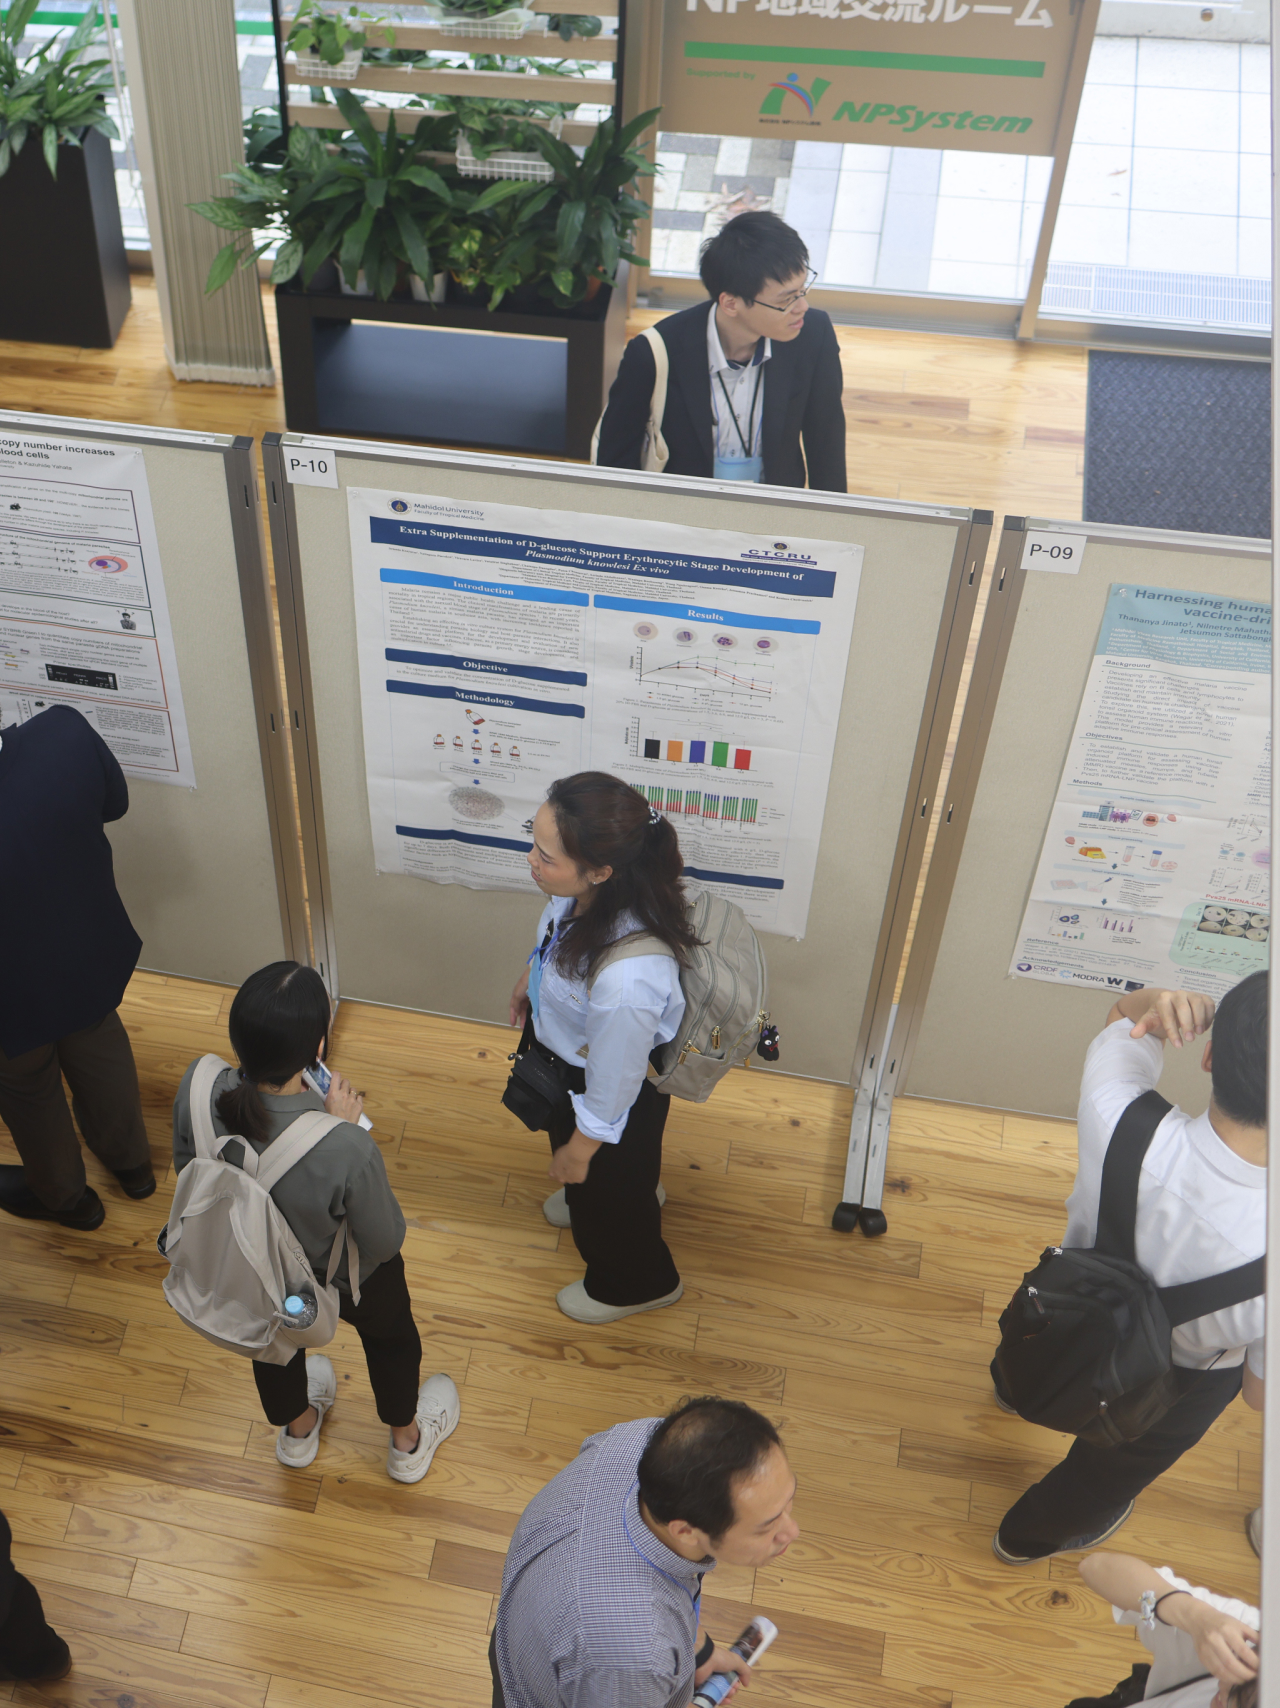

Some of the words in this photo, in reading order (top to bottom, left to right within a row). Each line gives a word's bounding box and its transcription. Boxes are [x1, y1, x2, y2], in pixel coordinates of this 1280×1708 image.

[686, 68, 740, 80] Supported
[742, 71, 756, 81] by
[832, 101, 1034, 134] NPSystem
[23, 440, 63, 452] number
[65, 444, 116, 457] increases
[26, 450, 50, 460] cells
[290, 458, 328, 474] P-10
[414, 502, 444, 512] Mahidol
[445, 506, 485, 517] University
[439, 512, 460, 520] Tropical
[399, 525, 427, 536] Extra
[429, 528, 513, 547] Supplementation
[516, 539, 528, 547] of
[528, 540, 578, 555] D-glucose
[579, 547, 621, 560] Support
[624, 553, 689, 569] Erythrocytic
[690, 560, 719, 572] Stage
[722, 564, 790, 578] Development
[748, 549, 812, 560] CTCRU
[1029, 543, 1074, 560] P-09
[525, 549, 585, 566] Plasmodium
[587, 557, 631, 570] knowlesi
[632, 563, 648, 572] Ex
[650, 566, 670, 575] vivo
[453, 580, 515, 596] Introduction
[1135, 589, 1224, 609] Harnessing
[687, 608, 724, 622] Results
[1118, 614, 1160, 627] Thananya
[1196, 622, 1232, 632] Nilnetre
[1179, 628, 1222, 638] Jetsumon
[463, 660, 508, 673] Objective
[1105, 659, 1151, 668] Background
[1106, 675, 1134, 683] presents
[1106, 680, 1134, 688] Vaccines
[1108, 670, 1143, 679] Developing
[1163, 676, 1189, 685] effective
[455, 690, 516, 706] Methodology
[1085, 732, 1123, 741] Objectives
[1072, 778, 1103, 786] Methods
[1026, 937, 1059, 945] Reference
[1022, 955, 1085, 969] Acknowledgements
[1033, 964, 1059, 973] CRDF
[1032, 969, 1056, 977] GLOBAL
[1072, 972, 1105, 983] MODRA
[1179, 968, 1217, 978] Conclusion
[1107, 976, 1124, 986] W
